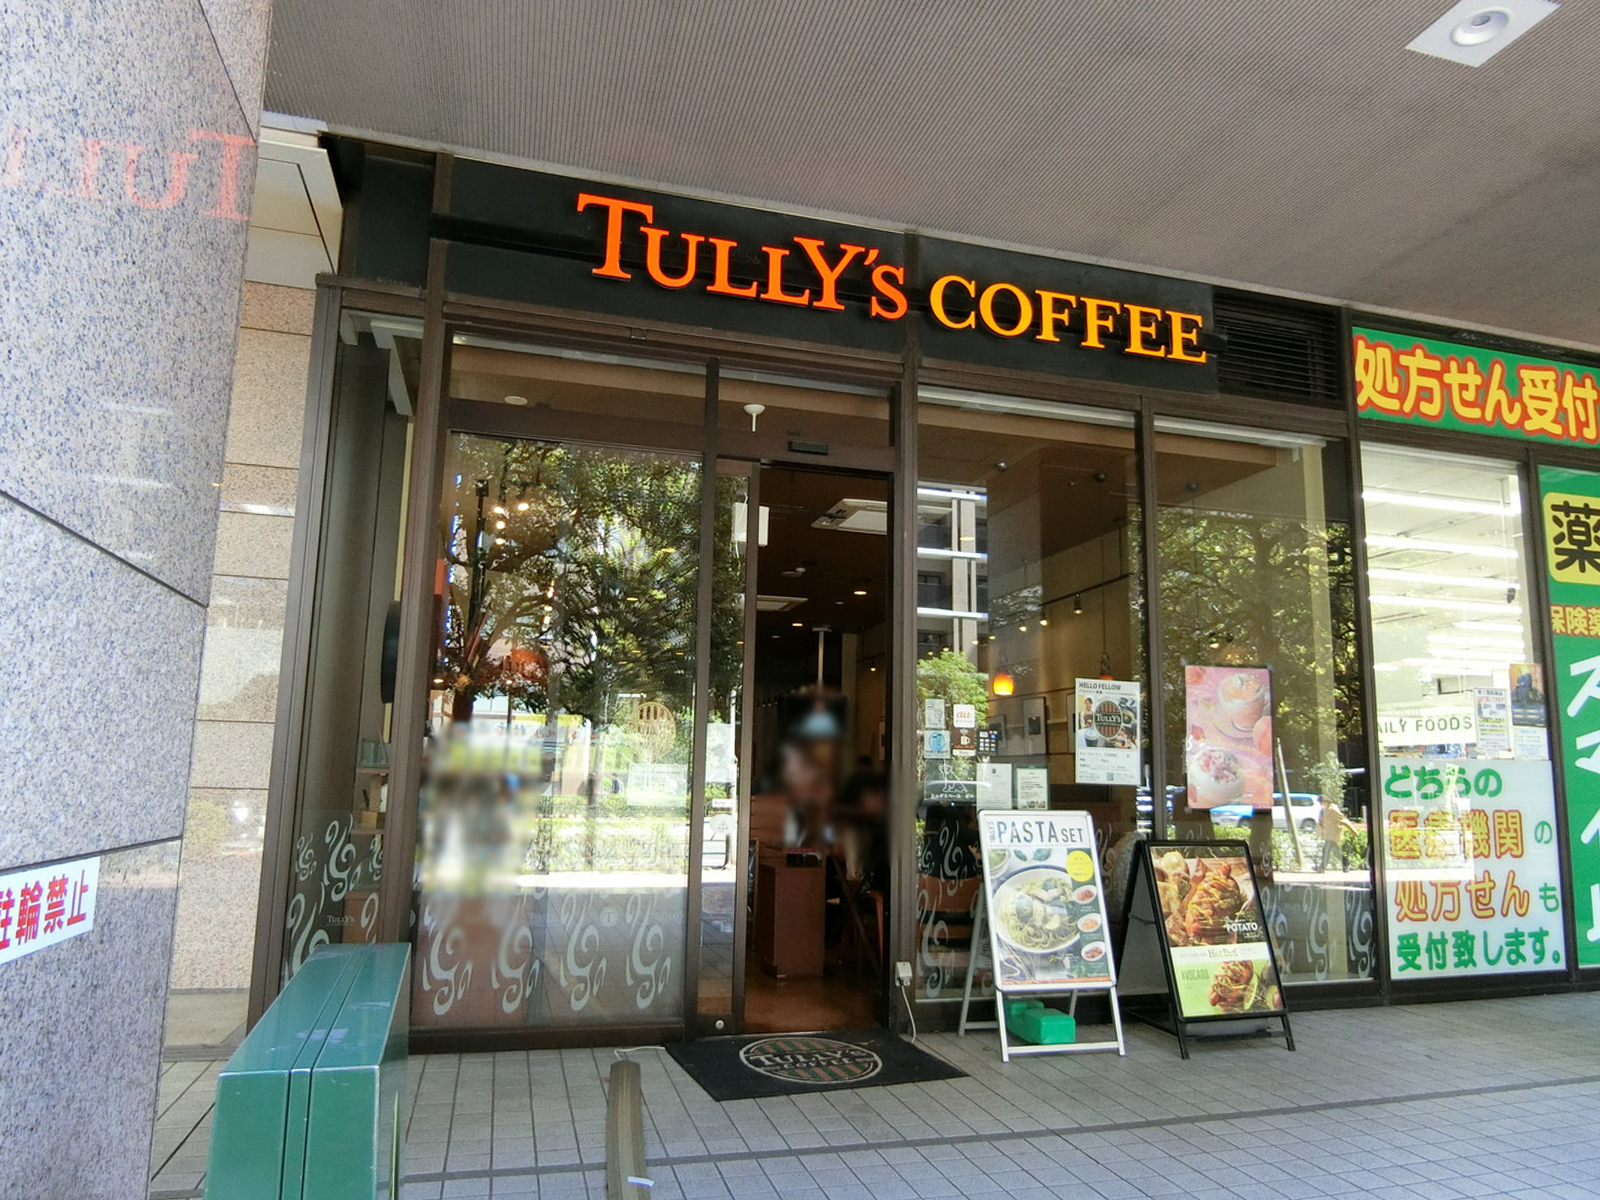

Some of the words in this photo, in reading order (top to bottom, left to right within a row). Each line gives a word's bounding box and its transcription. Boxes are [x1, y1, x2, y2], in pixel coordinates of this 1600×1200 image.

[577, 193, 908, 320] TULLY'S
[930, 275, 1207, 364] COFFEE
[1354, 336, 1600, 442] 処方せん受付
[1550, 500, 1600, 573] 薬
[1098, 683, 1122, 691] FELLOW
[956, 711, 971, 719] au
[1415, 716, 1473, 732] FOODS
[997, 820, 1059, 844] PASTA
[1061, 828, 1084, 843] SET
[1227, 922, 1258, 932] POTATO
[1397, 927, 1561, 972] 受付致します。
[1181, 968, 1209, 981] AVOCADO
[750, 1049, 867, 1066] TULLY'S
